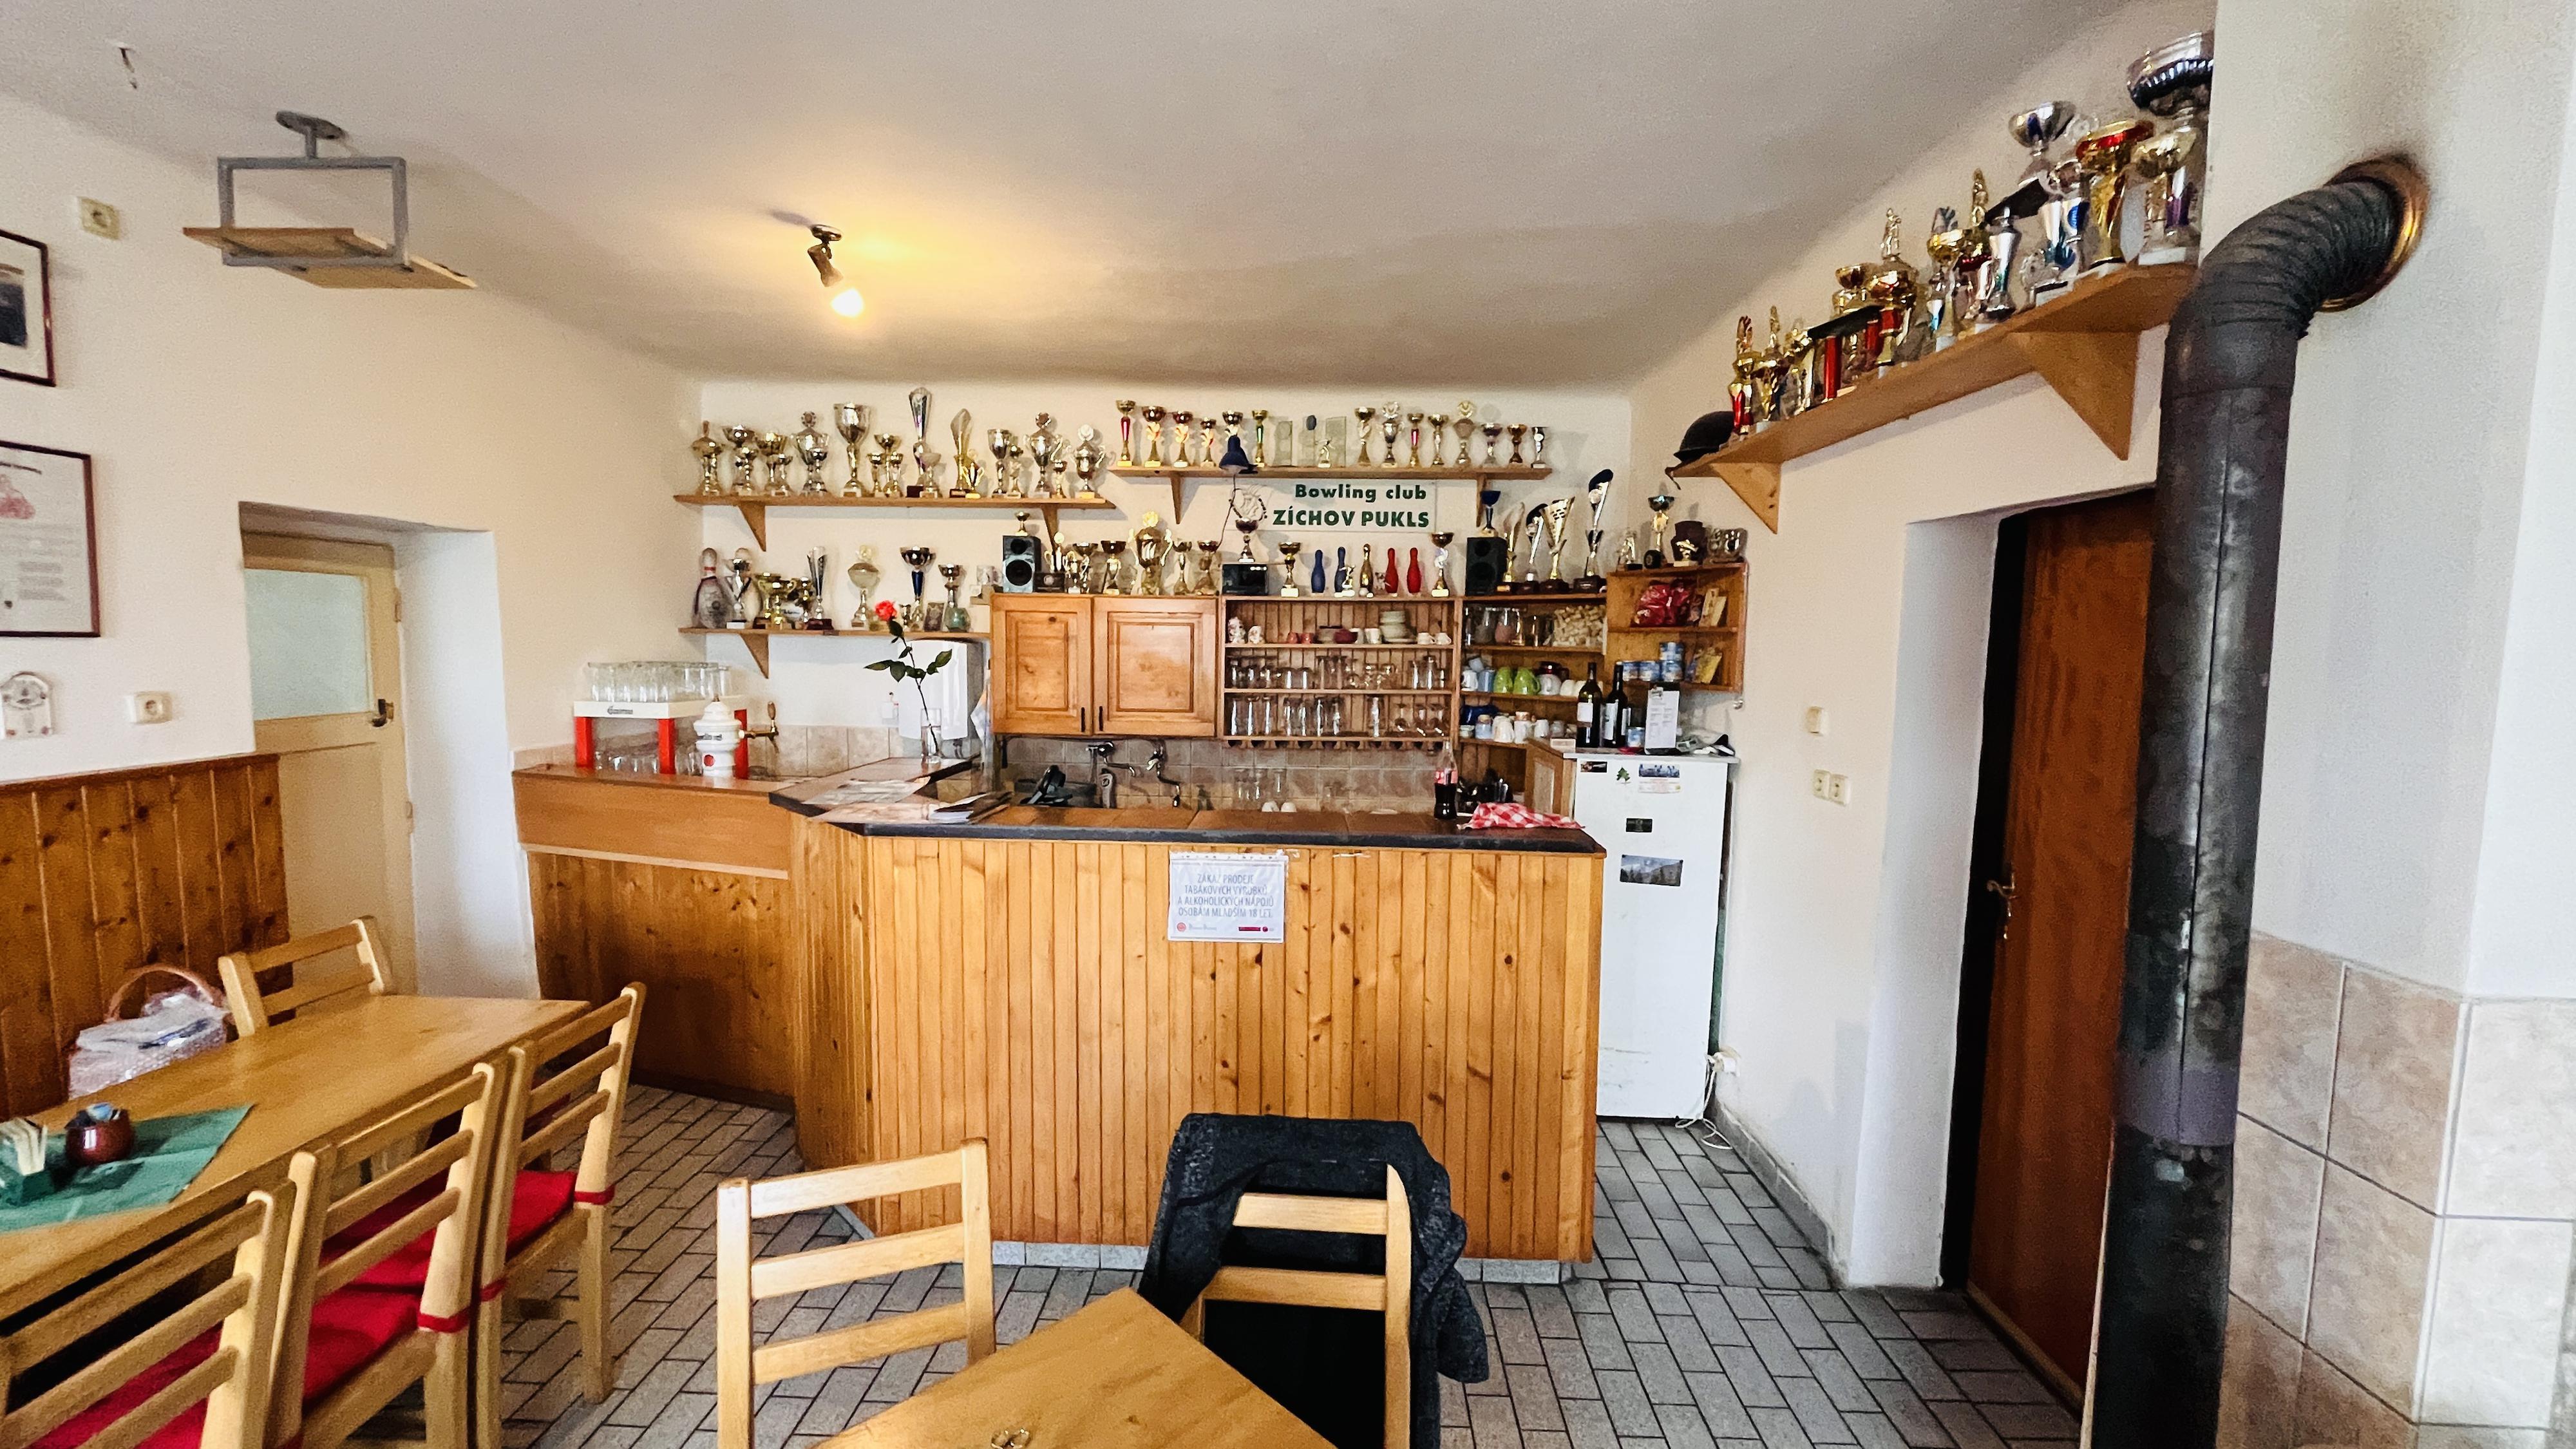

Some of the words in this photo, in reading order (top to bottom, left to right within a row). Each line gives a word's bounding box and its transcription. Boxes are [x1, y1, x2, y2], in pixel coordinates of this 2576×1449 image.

[1295, 484, 1377, 503] Bowling
[1386, 485, 1427, 500] club
[1273, 506, 1356, 526] ZÍCHOV
[1361, 510, 1429, 527] PUKLS
[1223, 874, 1255, 884] PRODEJE
[1184, 883, 1231, 895] TABÁKOVÝCH
[1177, 896, 1182, 905] A
[1184, 895, 1244, 907] ALKOHOLICKÝCH
[1245, 895, 1274, 907] NÁPOJŮ
[1178, 906, 1210, 916] OSOBÁM
[1249, 909, 1258, 918] 18
